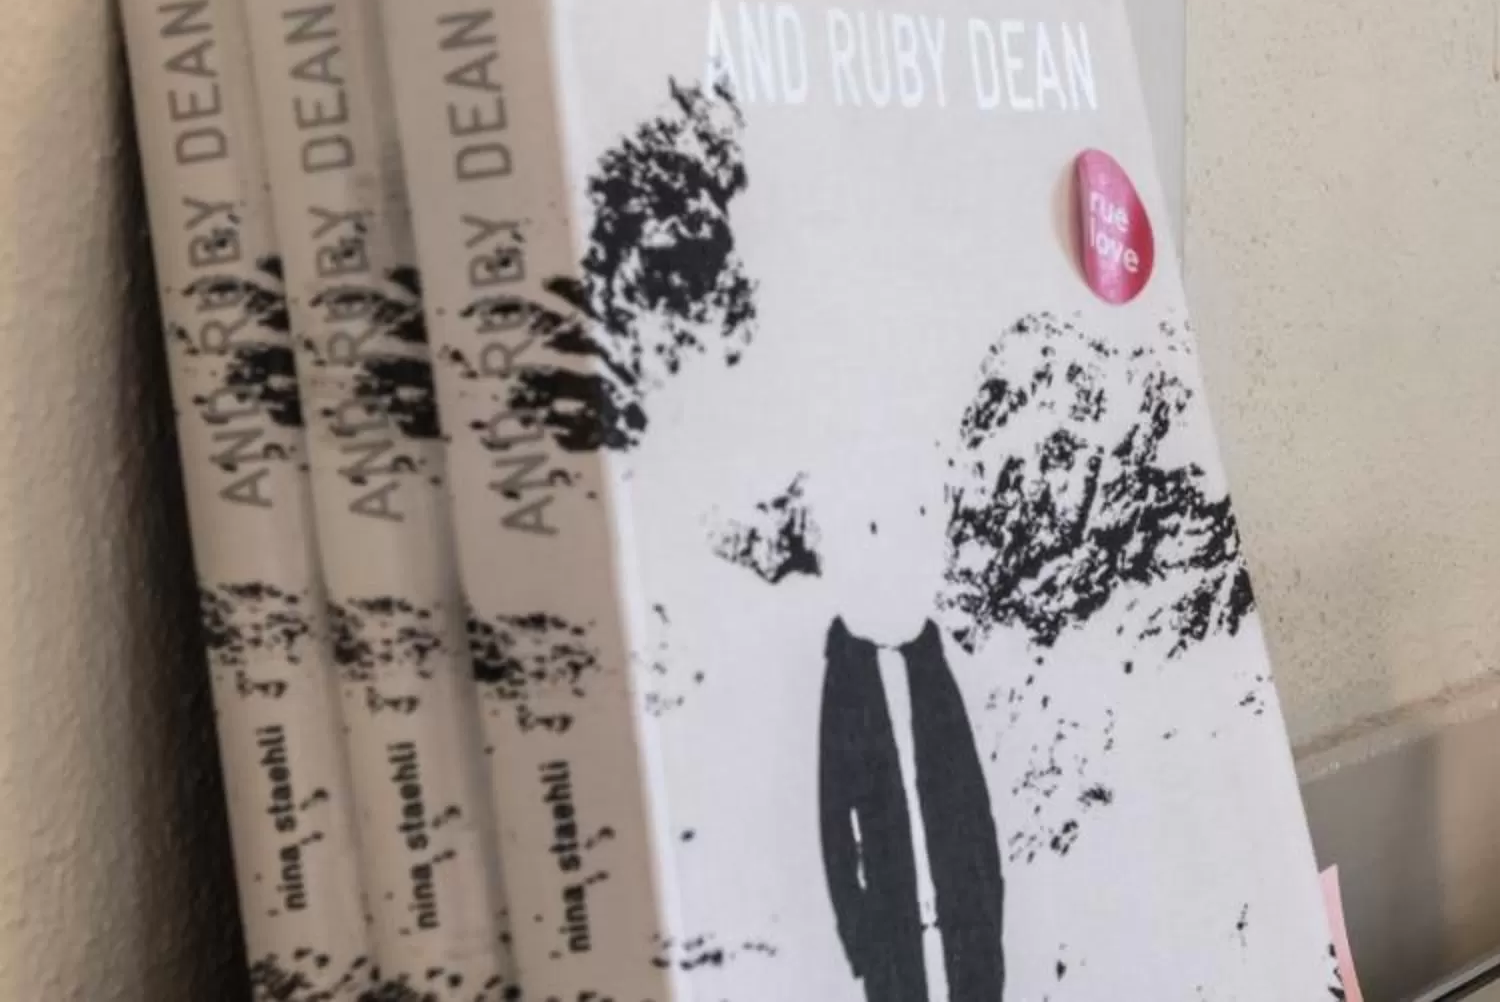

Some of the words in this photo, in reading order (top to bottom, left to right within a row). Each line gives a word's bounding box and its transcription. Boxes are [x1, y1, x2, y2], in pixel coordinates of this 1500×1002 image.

[281, 3, 355, 174] DEAN
[436, 8, 512, 181] DEAN
[827, 7, 946, 109] RUBY
[968, 17, 1098, 112] DEAN
[181, 195, 258, 356] RUBY
[308, 204, 386, 367] RUBY
[460, 213, 550, 378] RUBY
[1091, 215, 1140, 274] love
[207, 385, 273, 510] AND
[337, 399, 405, 523] AND
[488, 408, 558, 536] AND
[256, 724, 298, 833] staehli
[386, 741, 429, 851] staehli
[538, 760, 582, 873] staehli
[276, 844, 308, 912] nina
[408, 862, 440, 930] nina
[558, 884, 591, 954] nina
